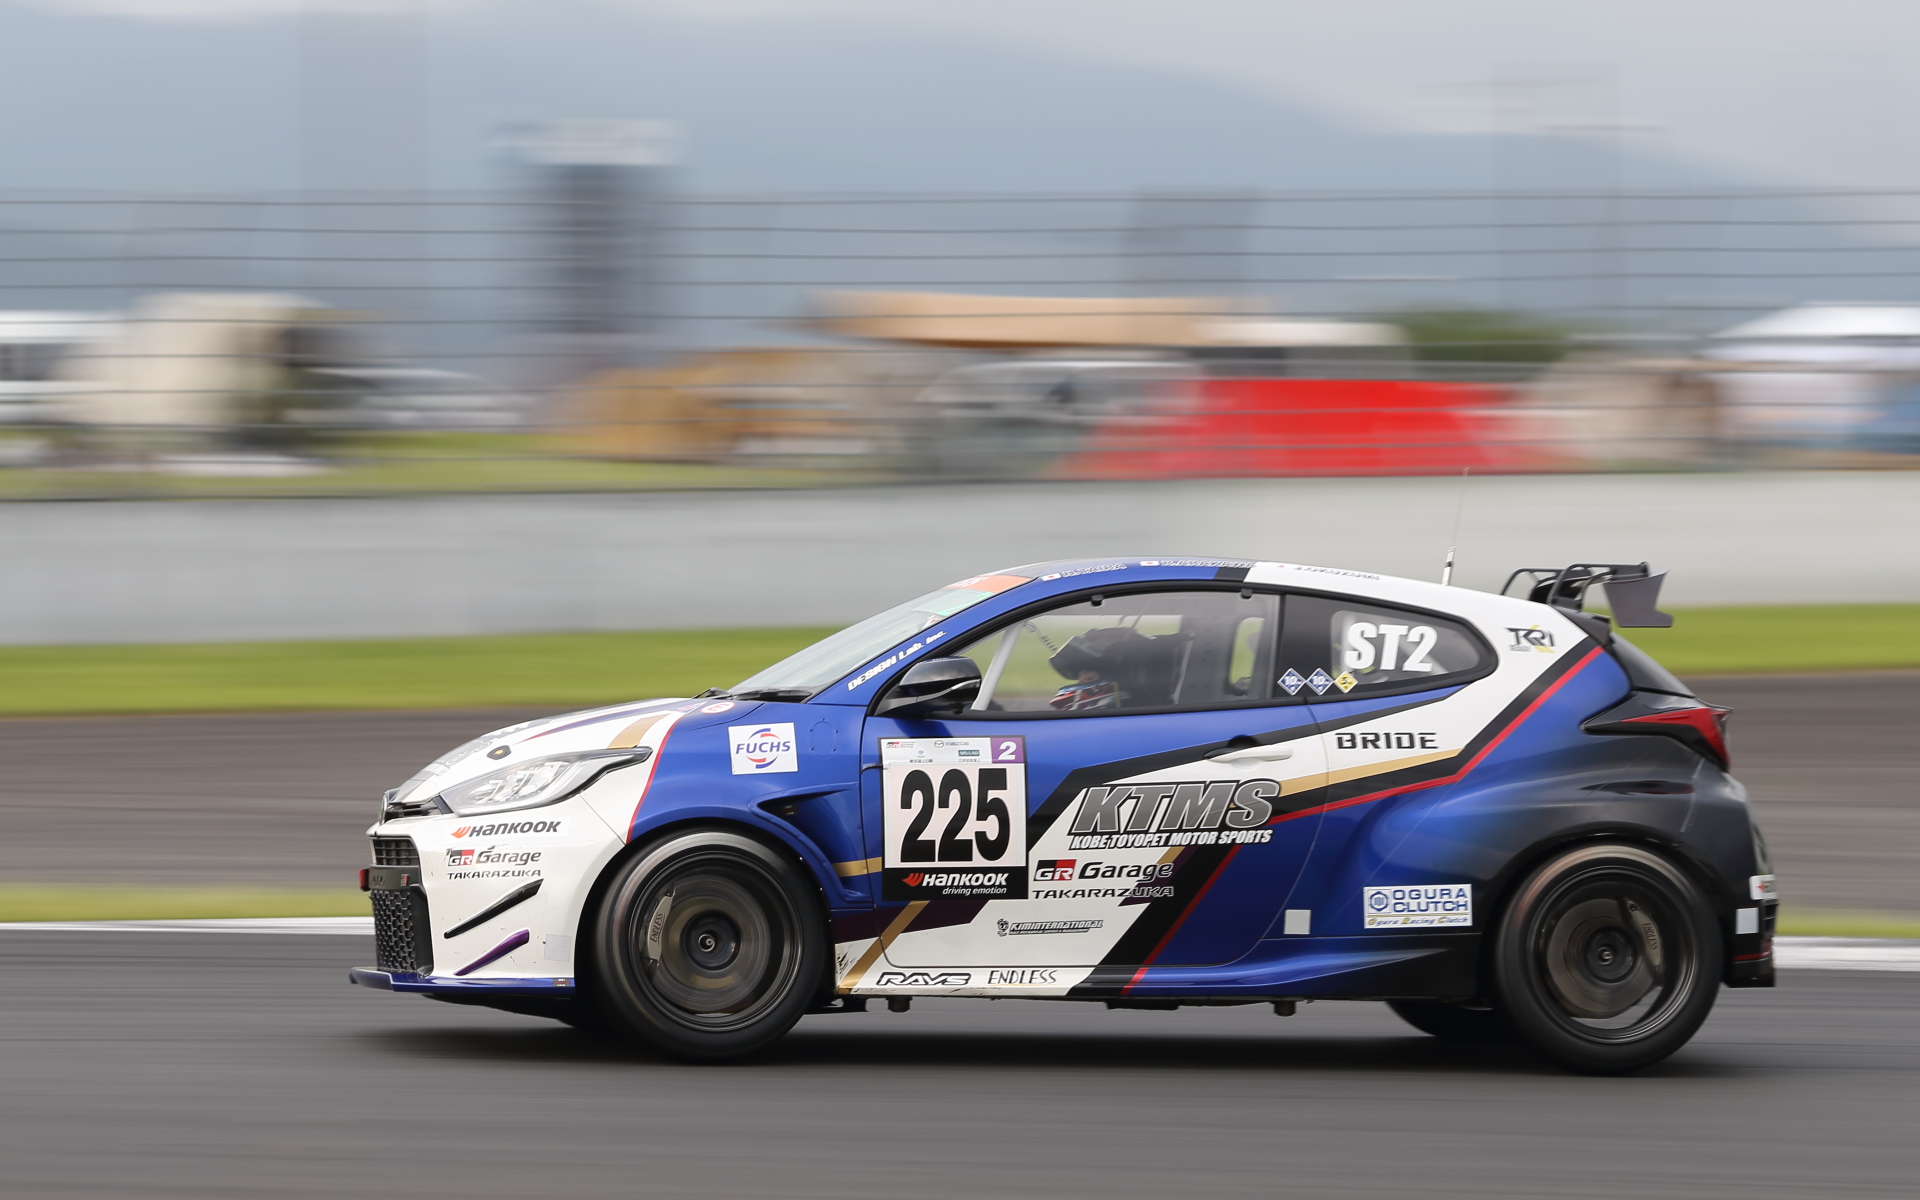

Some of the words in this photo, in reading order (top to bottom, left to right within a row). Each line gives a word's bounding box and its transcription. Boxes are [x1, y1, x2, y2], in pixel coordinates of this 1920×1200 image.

[1345, 622, 1438, 672] ST2
[847, 655, 897, 691] DESIGN
[898, 642, 925, 660] Lab.
[926, 630, 947, 645] Inc.
[735, 741, 791, 754] FUCHS
[1335, 732, 1439, 749] BRIDE
[998, 741, 1017, 760] 2
[1070, 779, 1280, 833] KTMS
[900, 768, 1011, 862] 225
[1071, 834, 1109, 849] KOBE
[1109, 832, 1170, 848] TOYOPET
[1168, 831, 1219, 846] MOTOR
[1218, 829, 1274, 845] SPORTS
[476, 850, 542, 866] Garage
[447, 869, 542, 880] TAKARAZUKA
[1034, 867, 1074, 881] GR
[1078, 862, 1174, 883] Garage
[942, 887, 971, 896] driving
[1032, 886, 1174, 899] TAKARAZUKA
[1393, 888, 1468, 900] OGURA
[1393, 901, 1469, 912] CLUTCH
[650, 913, 664, 943] ENDLESS
[1368, 918, 1398, 926] Ogura
[1401, 917, 1435, 925] Racing
[1438, 916, 1469, 924] Clutch
[876, 972, 972, 986] RAYS
[987, 969, 1058, 984] ENDLESS
